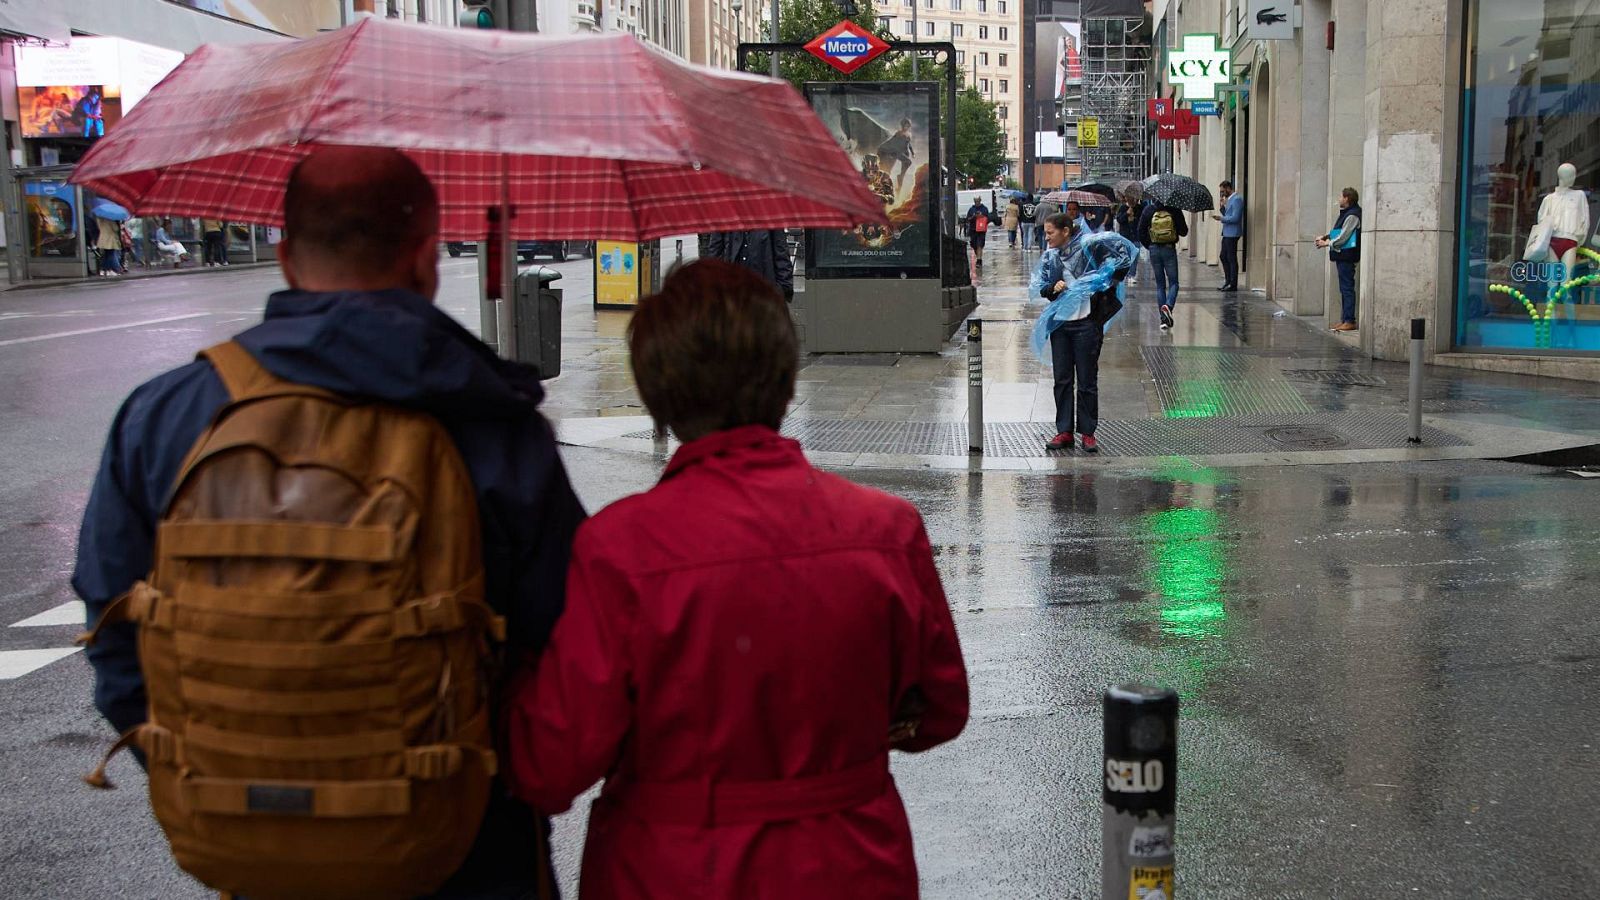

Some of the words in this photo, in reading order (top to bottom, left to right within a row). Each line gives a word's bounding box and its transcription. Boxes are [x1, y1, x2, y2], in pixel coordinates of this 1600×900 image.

[828, 41, 866, 53] Metro
[1510, 261, 1567, 283] CLUB
[1106, 758, 1165, 794] SELO
